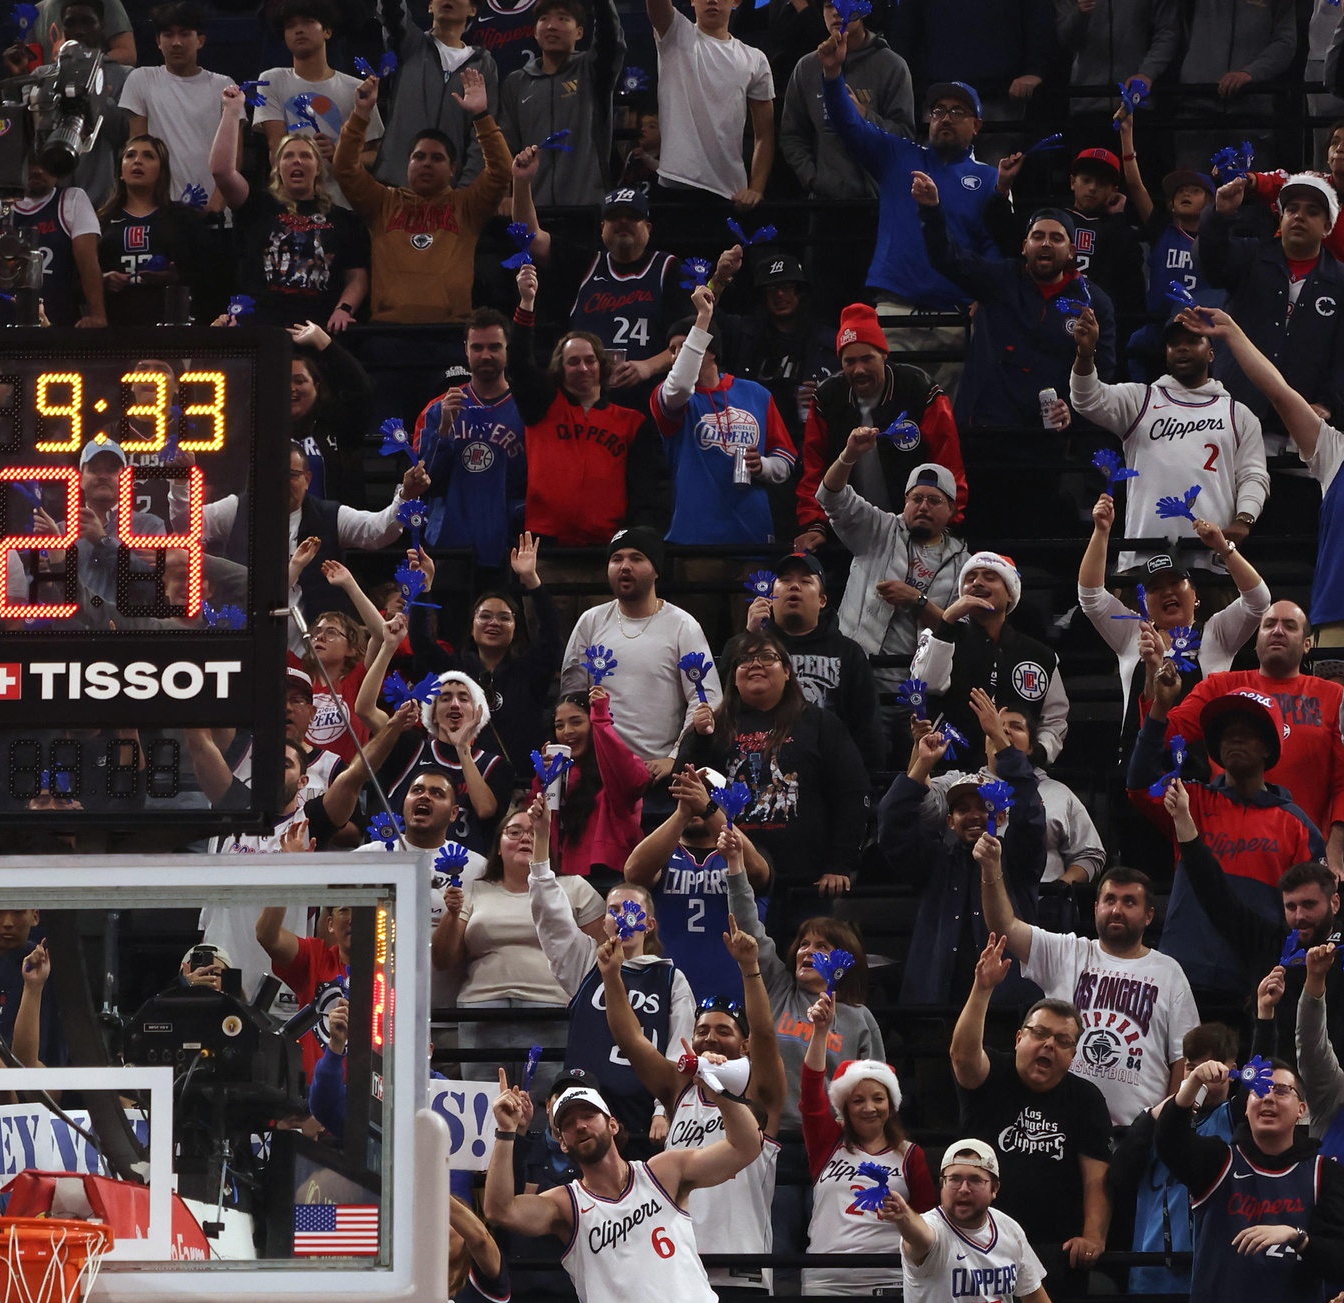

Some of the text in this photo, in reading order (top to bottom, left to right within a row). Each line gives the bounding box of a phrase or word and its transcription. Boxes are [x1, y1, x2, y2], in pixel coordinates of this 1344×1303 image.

[769, 260, 785, 275] LA
[584, 289, 653, 313] Clippers
[613, 316, 650, 346] 24
[36, 371, 224, 452] 9:33
[1150, 415, 1225, 443] Clippers
[1202, 443, 1220, 472] 2
[29, 661, 241, 701] TISSOT
[455, 806, 469, 837] 3
[1202, 832, 1280, 857] Clippers
[662, 866, 729, 896] CLIPPERS
[687, 898, 707, 933] 2
[1126, 1056, 1142, 1072] 84
[1017, 1114, 1059, 1133] Angeles
[1023, 1105, 1042, 1120] Los
[997, 1125, 1066, 1161] Clippers
[1227, 1192, 1306, 1217] Clippers
[588, 1198, 663, 1254] Clippers
[651, 1226, 677, 1259] 6
[951, 1266, 1018, 1300] CLIPPERS
